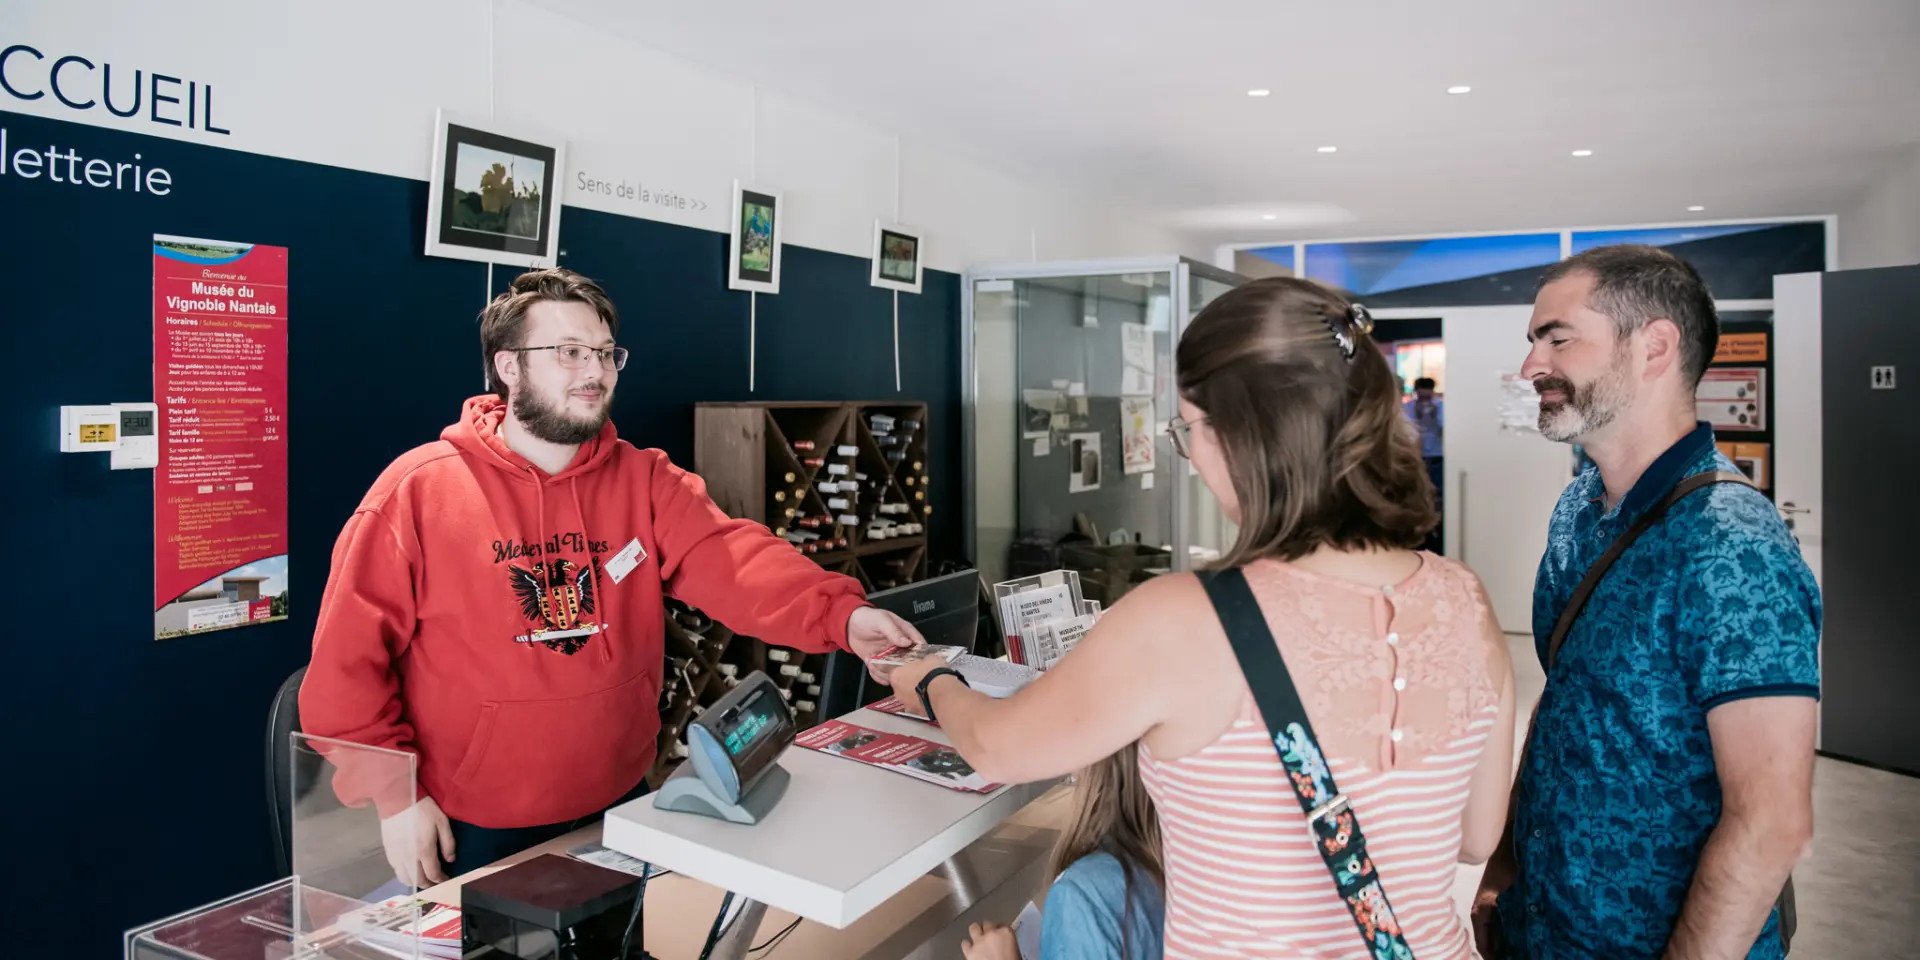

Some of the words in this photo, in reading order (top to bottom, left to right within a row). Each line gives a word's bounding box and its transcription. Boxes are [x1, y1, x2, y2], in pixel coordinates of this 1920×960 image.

[577, 171, 612, 196] Sens
[616, 180, 634, 200] de
[639, 182, 650, 203] la
[653, 188, 686, 210] visite
[202, 268, 236, 280] Bienvenue
[192, 281, 234, 297] Musée
[238, 285, 254, 298] du
[166, 295, 226, 312] Vignoble
[229, 300, 276, 315] Nantais
[166, 316, 198, 327] Horaires
[166, 396, 186, 404] Tarifs
